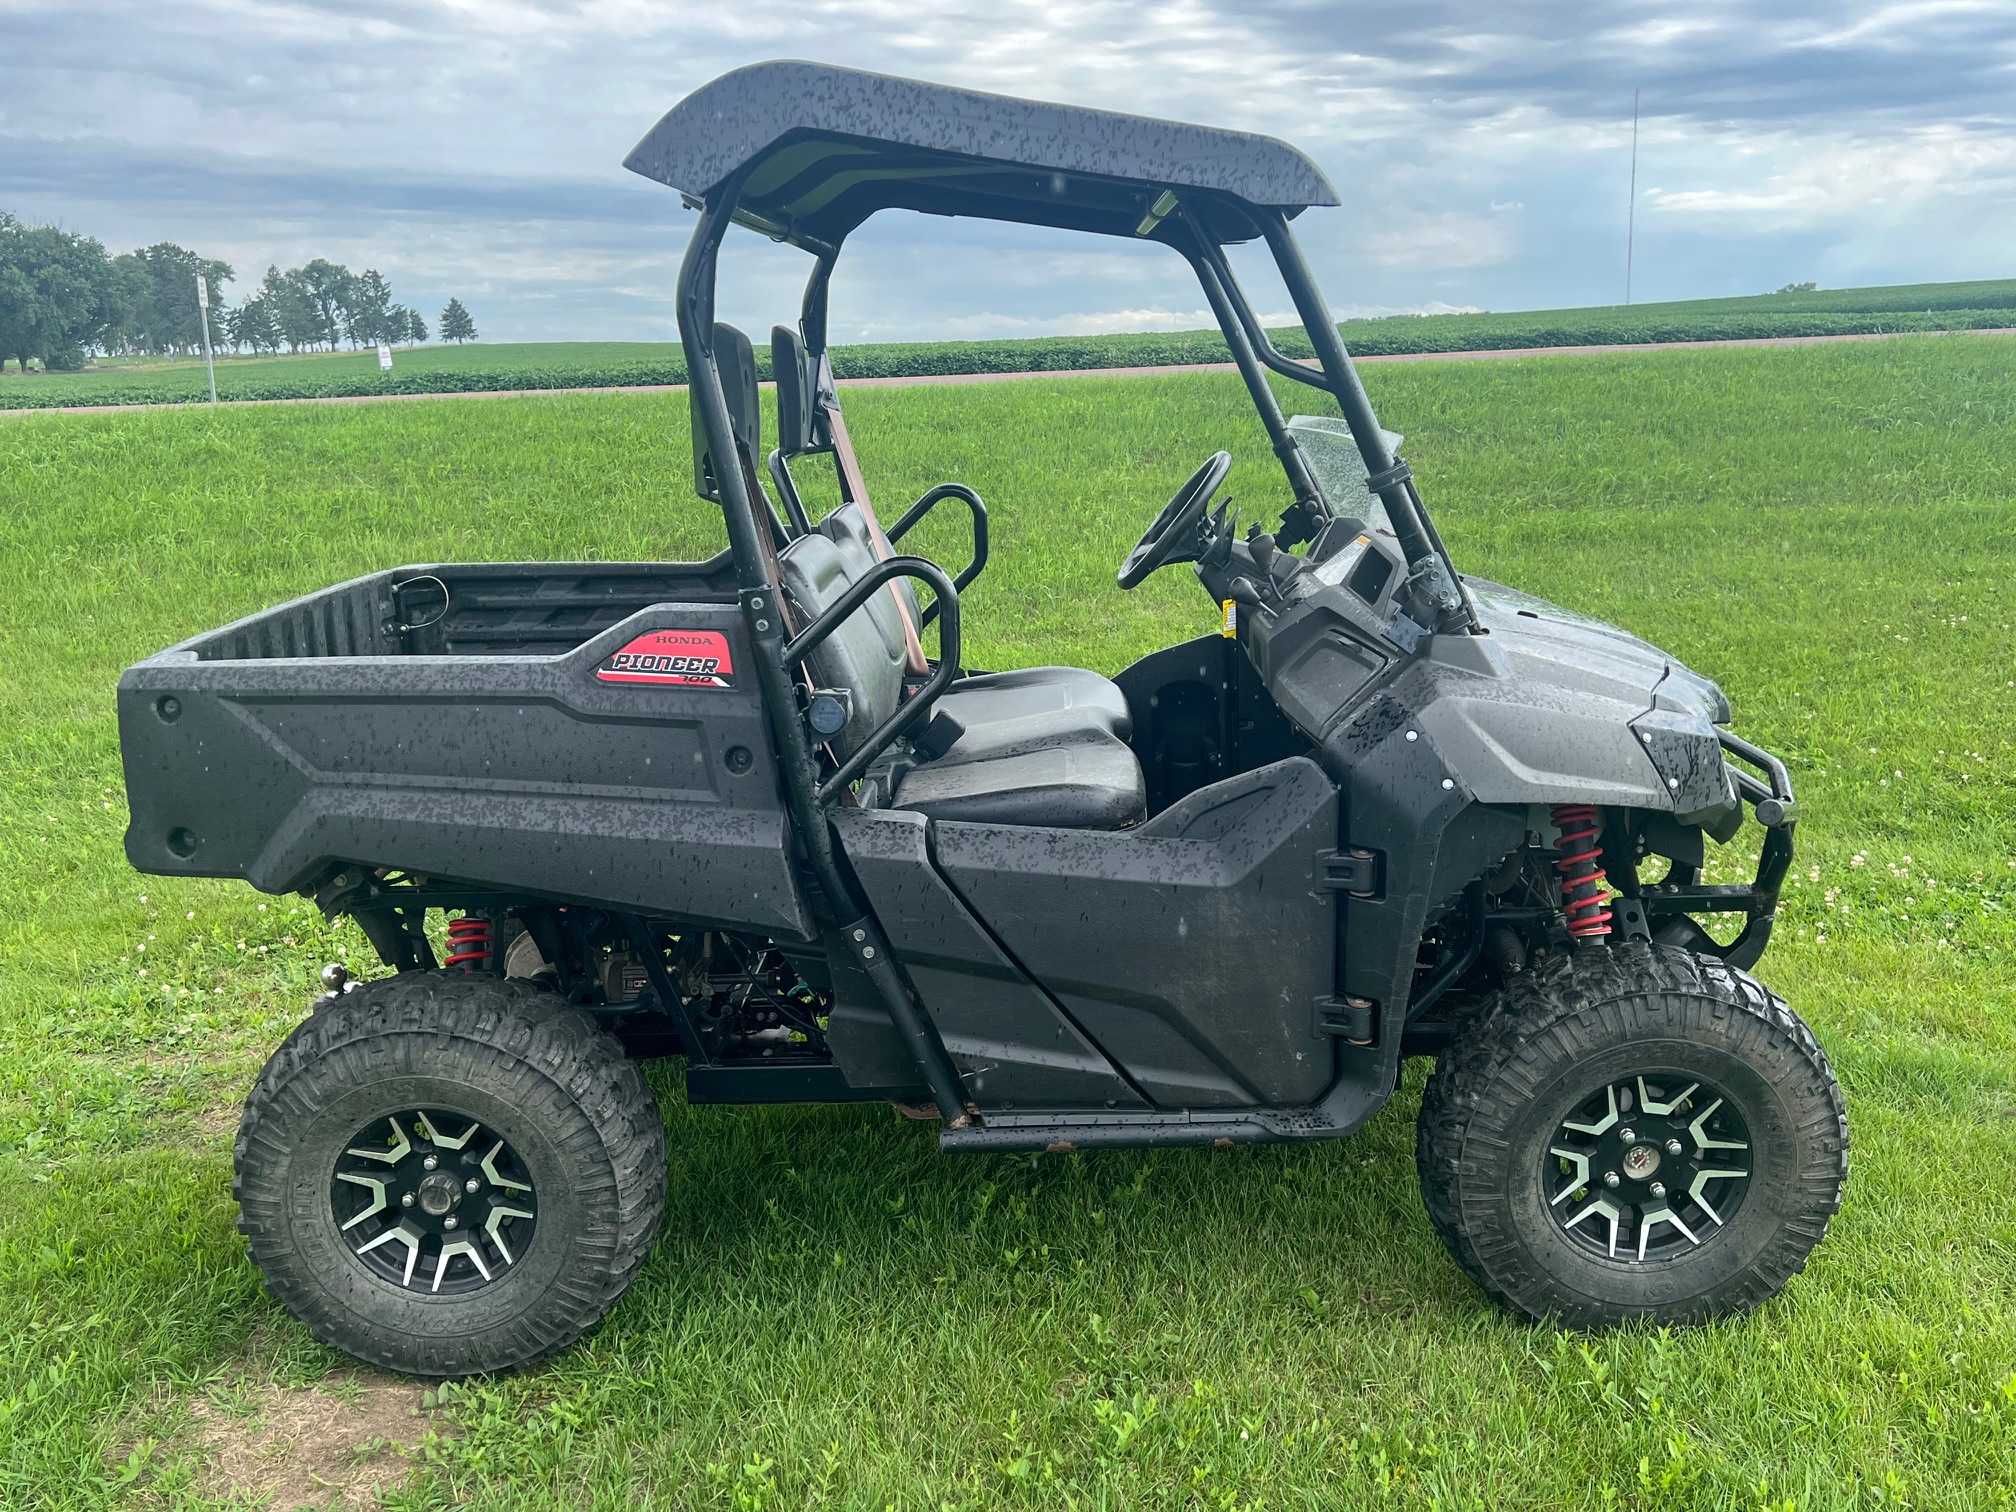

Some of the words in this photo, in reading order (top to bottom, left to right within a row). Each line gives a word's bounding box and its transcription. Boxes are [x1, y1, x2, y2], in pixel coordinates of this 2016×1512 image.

[655, 636, 713, 645] HONDA
[612, 653, 720, 674] PIONEER
[679, 675, 714, 683] 700
